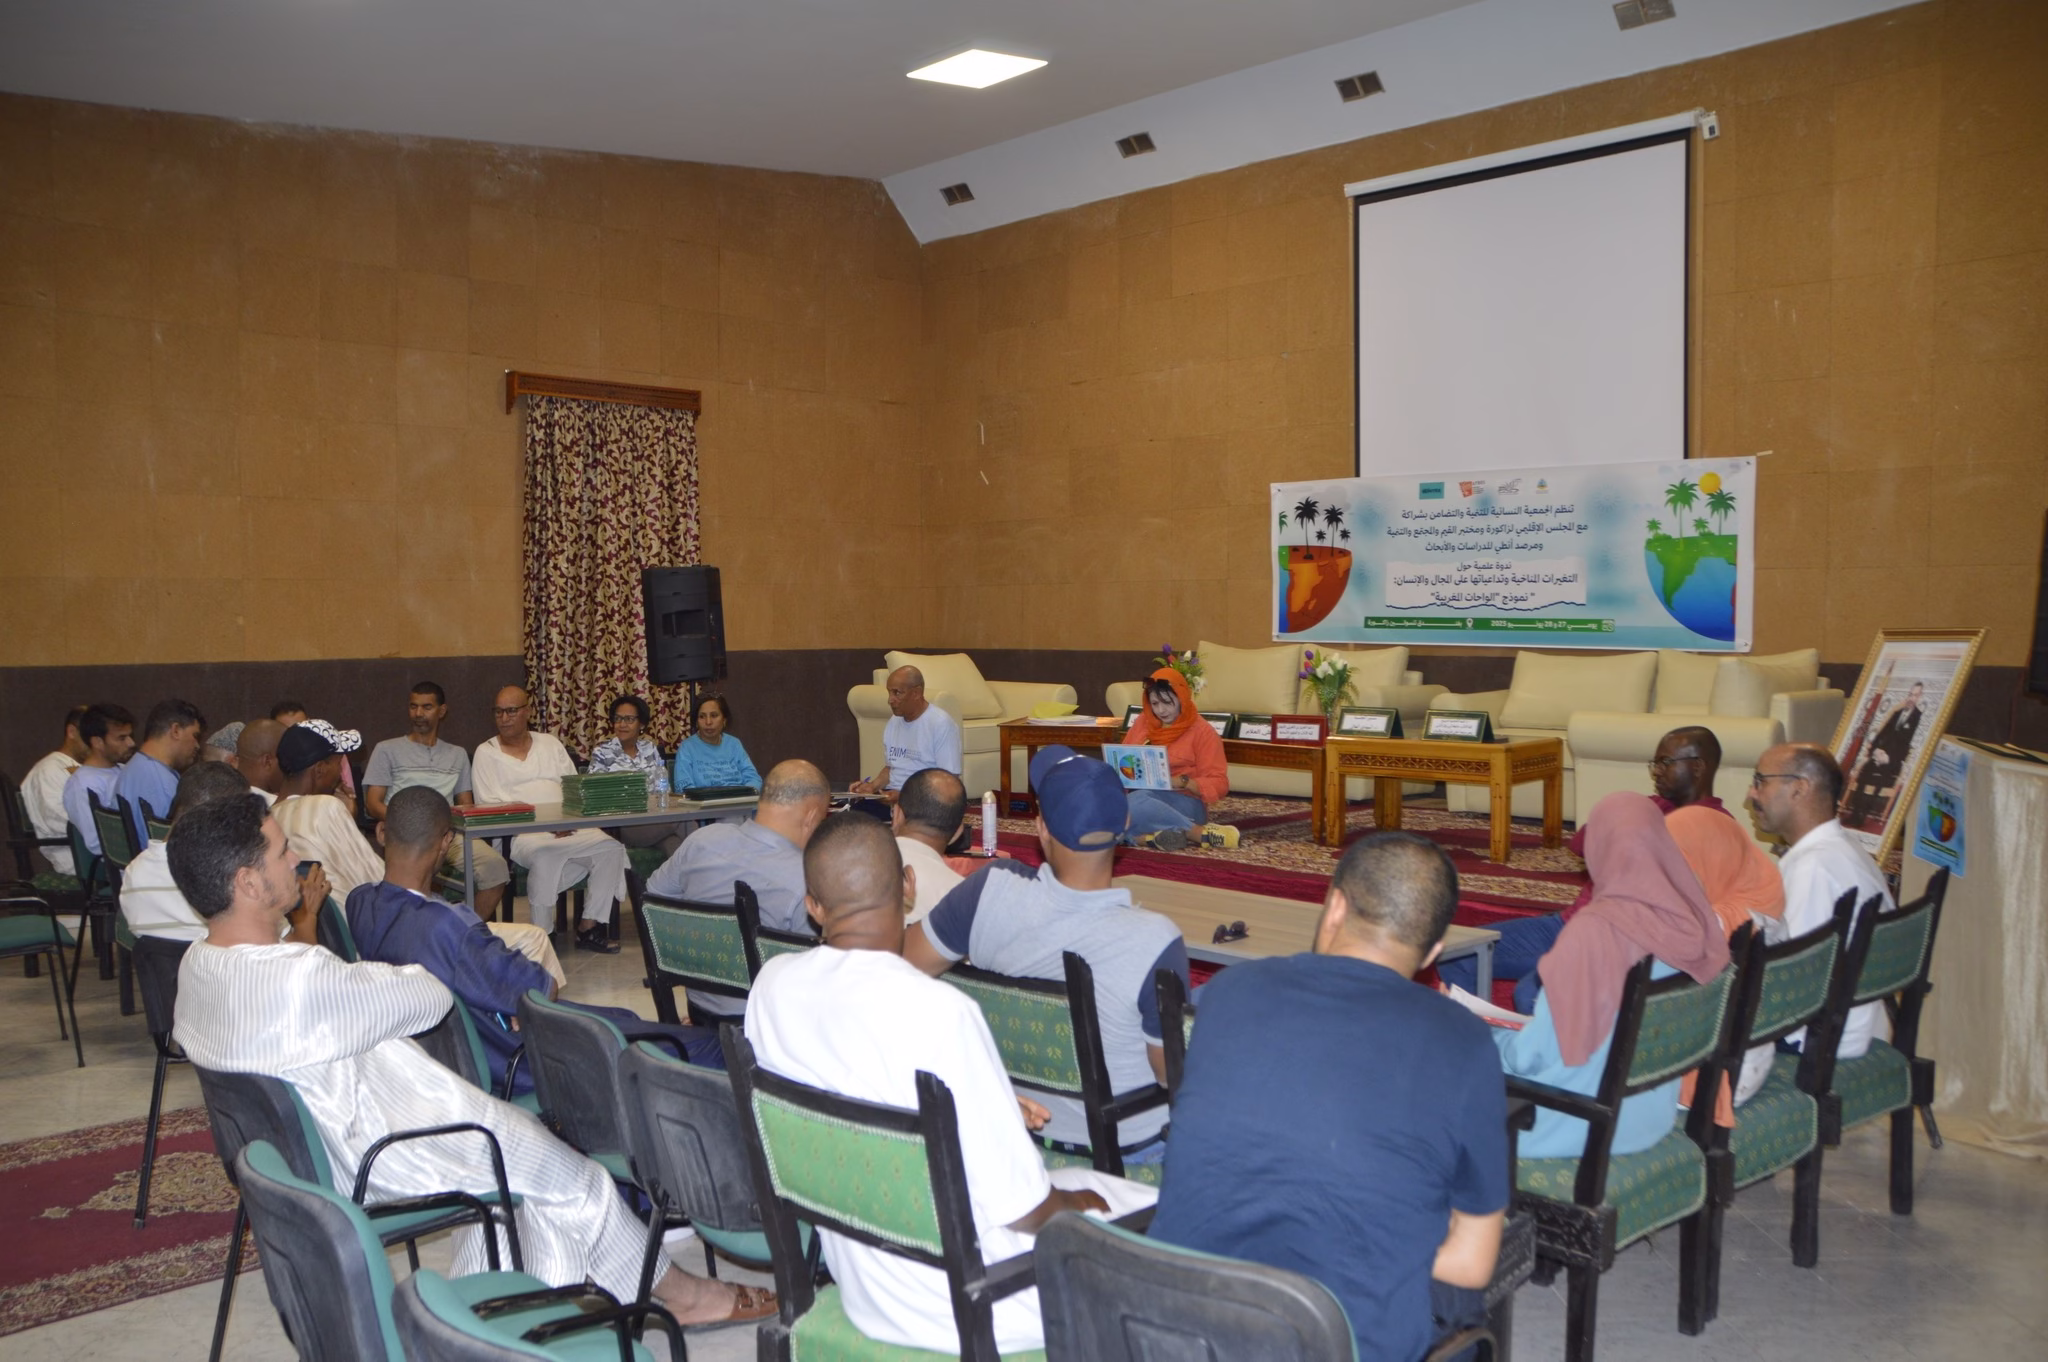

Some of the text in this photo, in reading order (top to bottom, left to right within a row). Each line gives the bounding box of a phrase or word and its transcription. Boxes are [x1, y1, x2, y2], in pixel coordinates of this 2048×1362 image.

[1402, 505, 1574, 520] تنظم الجمعية النسائية للتنمية والتضامن بشراكة
[1386, 522, 1589, 538] مع المجلس الإقليمي لزاكورة ومختبر القيم والمجتمع والتنمية
[1425, 540, 1456, 552] والأبحاث
[1457, 542, 1493, 552] للدراسات
[1514, 543, 1544, 552] ومرصد
[1456, 562, 1512, 572] ندوة علمية حول
[1431, 574, 1452, 586] المجال
[1454, 575, 1469, 586] على
[1470, 574, 1509, 586] وتداعياتها
[1511, 573, 1540, 586] المناخية
[1542, 573, 1578, 586] التغيرات
[1502, 592, 1528, 605] نموذج
[1544, 620, 1553, 628] 28
[1558, 620, 1567, 628] 27
[890, 746, 907, 757] ENIM
